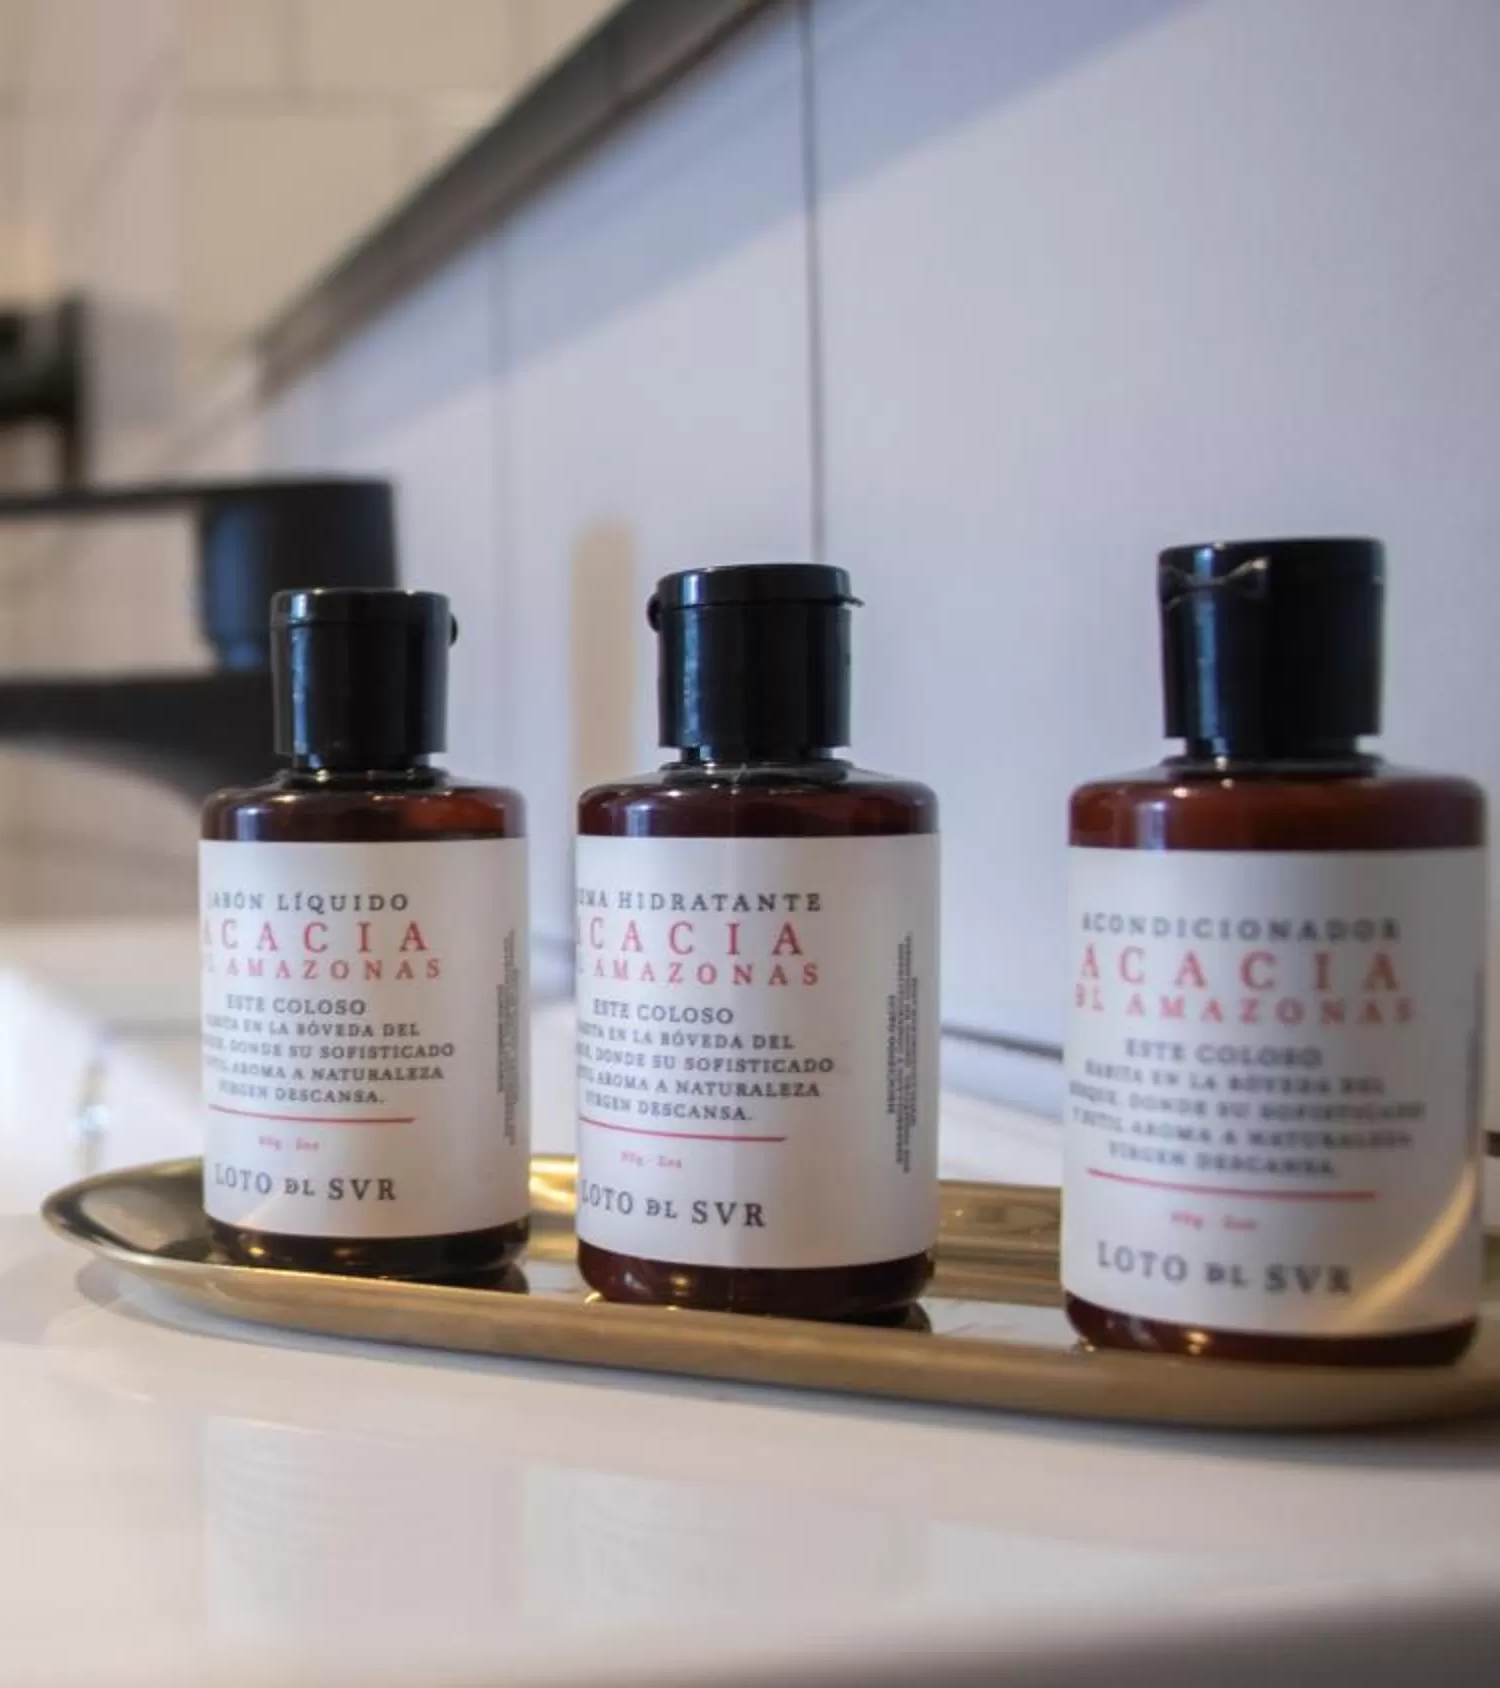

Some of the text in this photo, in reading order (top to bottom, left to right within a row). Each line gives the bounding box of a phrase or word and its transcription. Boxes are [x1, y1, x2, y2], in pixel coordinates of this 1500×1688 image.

[207, 889, 409, 914] ABÓN LÍQUIDO
[617, 890, 822, 913] HIDRATANTE
[577, 916, 804, 956] CACIA
[1082, 912, 1400, 943] ACONDICIONADOR
[226, 956, 442, 981] AMAZONAS
[593, 957, 820, 987] AMAZONAS
[1081, 943, 1399, 993] ACACIA
[226, 993, 367, 1016] ESTE COLOSO
[593, 998, 734, 1025] ESTE COLOSO
[1126, 994, 1415, 1026] AMAZONAS
[268, 1020, 289, 1037] LA
[296, 1019, 375, 1038] BÓVEDA
[382, 1022, 421, 1038] DEL
[632, 1028, 653, 1045] LA
[660, 1028, 744, 1050] BÓVEDA
[752, 1035, 795, 1050] DEL
[288, 1044, 313, 1059] SU
[319, 1043, 455, 1060] SOFISTICADO
[595, 1046, 645, 1068] DONDE
[651, 1054, 677, 1070] SU
[683, 1055, 835, 1074] SOFISTICADO
[1125, 1038, 1323, 1069] ESTE COLOSO
[292, 1066, 305, 1080] A
[311, 1066, 445, 1081] NATURALEZA
[275, 1087, 385, 1103] DESCANSA.
[655, 1079, 669, 1094] A
[675, 1080, 820, 1098] NATURALEZA
[637, 1100, 753, 1122] DESCANSA.
[214, 1163, 273, 1195] LOTO
[328, 1177, 397, 1201] SVR
[581, 1179, 634, 1215] LOTO
[691, 1200, 766, 1228] SVR
[1096, 1240, 1188, 1286] LOTO
[1264, 1262, 1352, 1295] SVR
